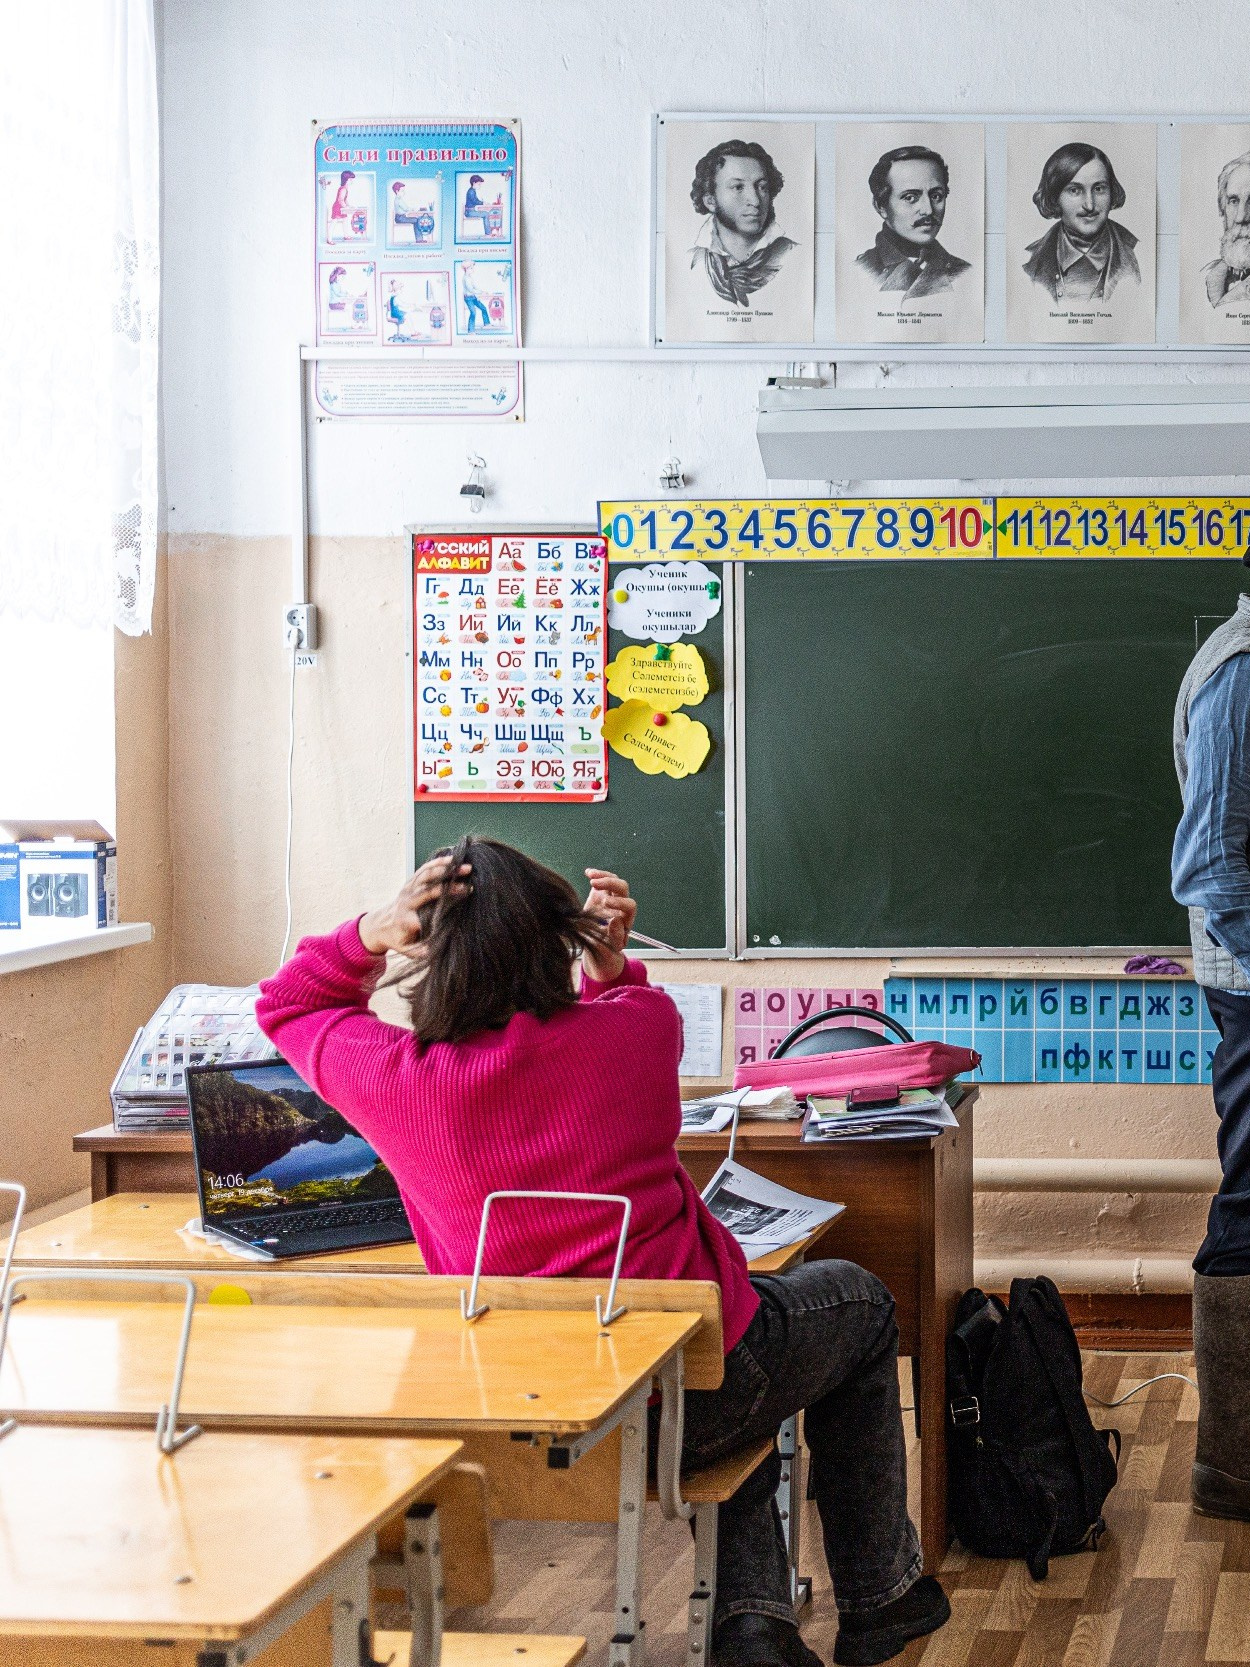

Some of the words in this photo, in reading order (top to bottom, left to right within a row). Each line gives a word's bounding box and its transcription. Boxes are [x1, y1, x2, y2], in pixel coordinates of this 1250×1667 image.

[323, 146, 378, 165] Сиди
[387, 147, 507, 165] правильно
[612, 513, 634, 548] 0
[640, 510, 657, 550] 1
[671, 510, 695, 550] 2
[704, 509, 729, 550] 3
[738, 509, 764, 549] 4
[774, 509, 798, 549] 5
[807, 509, 832, 549] 6
[841, 509, 866, 548] 7
[876, 508, 900, 548] 8
[910, 507, 935, 549] 9
[940, 507, 982, 548] 10
[1006, 509, 1033, 546] 11
[1039, 509, 1072, 546] 12
[1077, 509, 1109, 546] 13
[1114, 509, 1148, 546] 14
[1154, 509, 1186, 546] 15
[1191, 509, 1224, 546] 16
[430, 540, 490, 555] УССКИЙ
[498, 542, 522, 559] Аа
[537, 542, 561, 559] Бб
[417, 557, 490, 570] АЛФАВИТ
[649, 569, 687, 578] Ученик
[425, 578, 440, 594] Гг
[459, 578, 485, 596] Дд
[498, 579, 520, 595] Ее
[536, 576, 558, 595] Ёё
[570, 579, 600, 596] Жж
[667, 583, 708, 594] (окушы
[647, 609, 692, 618] Ученики
[423, 614, 445, 631] Зз
[459, 614, 483, 631] Ии
[498, 614, 521, 631] Йй
[536, 615, 558, 631] Кк
[571, 615, 594, 631] Лл
[296, 656, 315, 665] 20V
[421, 651, 450, 667] Мм
[461, 651, 483, 667] Нн
[497, 651, 521, 668] Оо
[534, 652, 557, 667] Пп
[572, 652, 595, 671] Рр
[630, 657, 693, 670] Здравствуйте
[687, 674, 697, 683] бе
[422, 687, 446, 704] Сс
[460, 688, 479, 703] Тт
[497, 688, 518, 707] Уу
[531, 687, 563, 707] Фф
[572, 688, 595, 705] Хх
[422, 724, 448, 742] Цц
[460, 724, 482, 740] Чч
[495, 725, 526, 740] Шш
[531, 725, 564, 743] Щщ
[644, 728, 677, 751] Привет
[496, 760, 522, 777] Ээ
[531, 760, 565, 777] Юю
[572, 761, 596, 777] Яя
[739, 992, 756, 1013] а
[767, 992, 786, 1013] о
[797, 993, 815, 1020] у
[890, 993, 908, 1014] н
[919, 994, 941, 1014] м
[950, 994, 969, 1014] л
[979, 994, 998, 1022] р
[1010, 988, 1028, 1016] й
[1040, 987, 1059, 1015] б
[1070, 996, 1088, 1015] в
[1099, 995, 1112, 1015] г
[1119, 996, 1141, 1020] д
[1147, 996, 1171, 1015] ж
[1179, 996, 1194, 1016] з
[1041, 1049, 1058, 1069] п
[1063, 1042, 1090, 1076] ф
[1099, 1050, 1114, 1070] к
[1122, 1050, 1137, 1070] т
[1147, 1050, 1171, 1070] ш
[1179, 1050, 1196, 1071] с
[208, 1173, 244, 1190] 14:06
